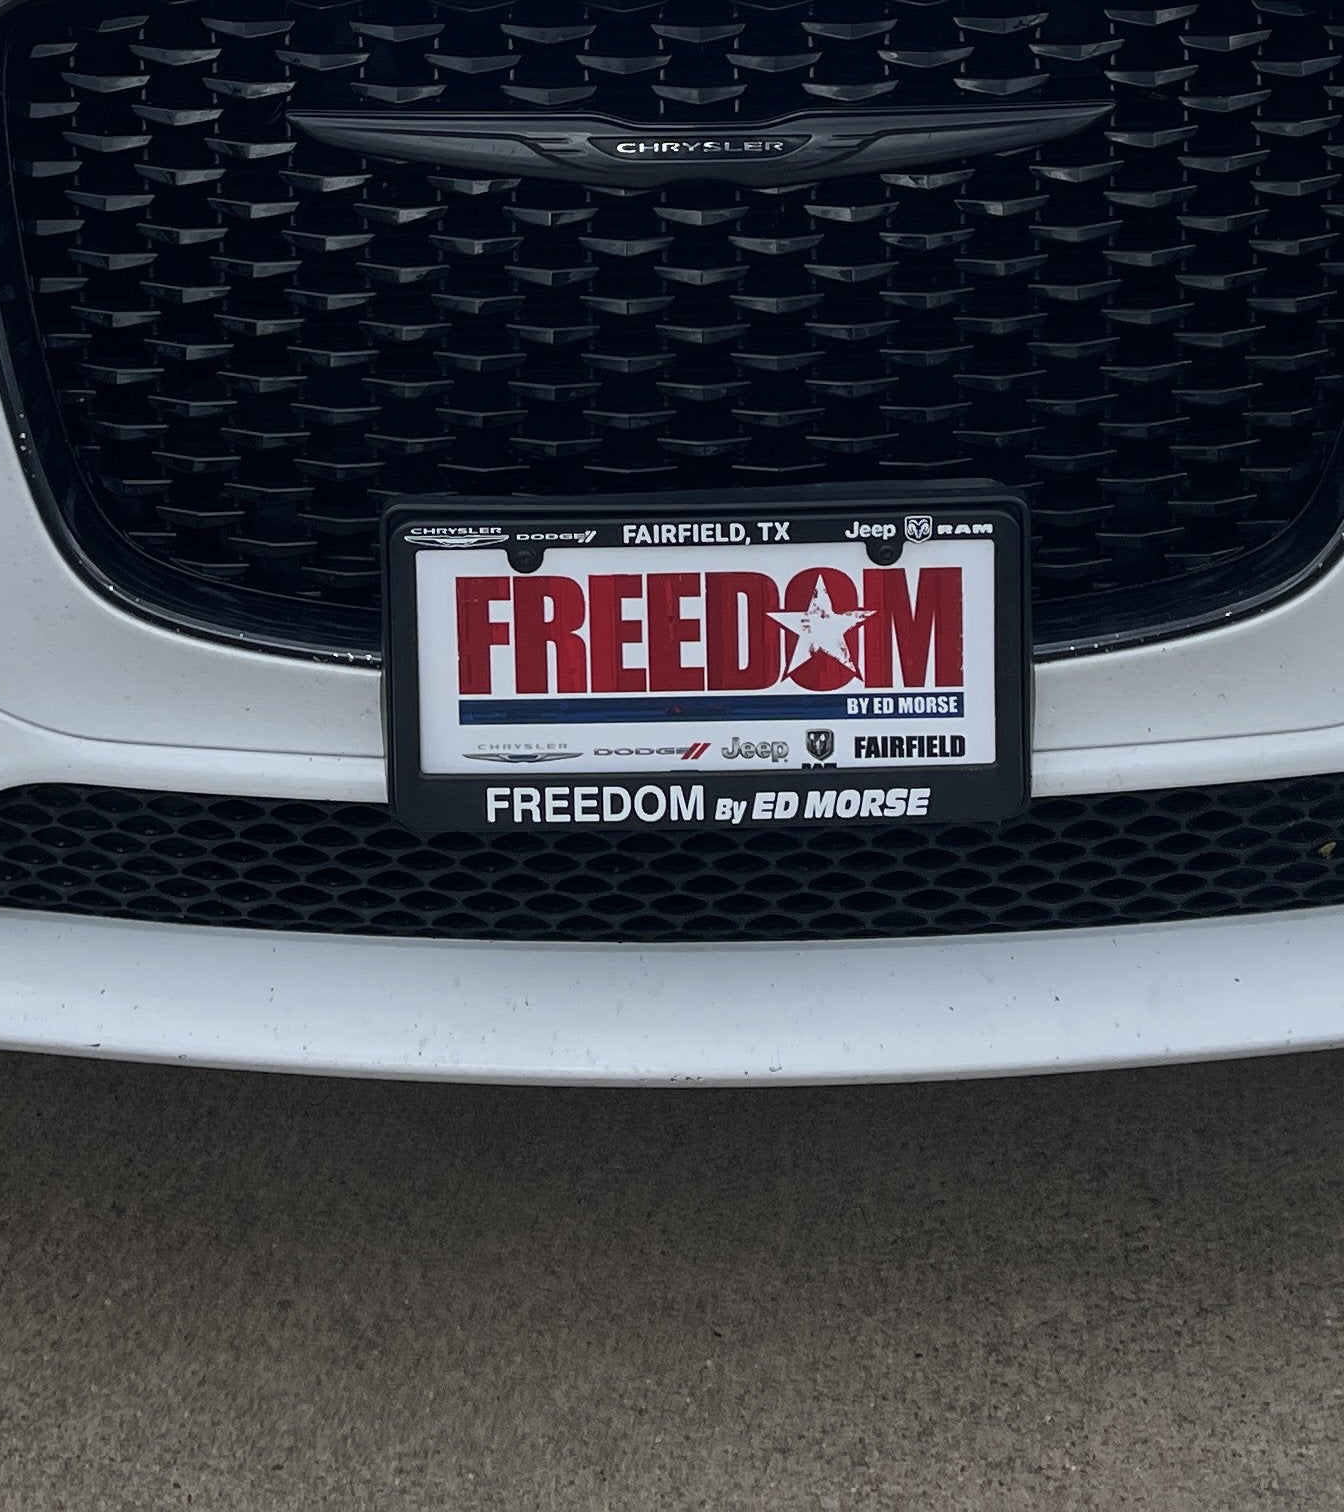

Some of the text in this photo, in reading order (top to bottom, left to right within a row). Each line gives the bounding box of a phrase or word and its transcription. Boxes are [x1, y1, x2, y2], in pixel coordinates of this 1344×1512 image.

[616, 141, 784, 153] CHRYSLER
[410, 527, 502, 535] CHRYSLER
[516, 533, 586, 541] DODGE
[623, 521, 790, 546] FAIRFIELD, TX
[845, 521, 896, 540] Jeep
[937, 523, 993, 535] RAM
[455, 567, 964, 694] FREEDOM
[847, 696, 958, 715] BY ED MORSE
[477, 743, 568, 751] CHRYSLER
[593, 746, 690, 756] DODGE
[721, 737, 789, 762] Jeep
[854, 735, 965, 758] FAIRFIELD
[486, 784, 931, 824] FREEDOM By ED MORSE
